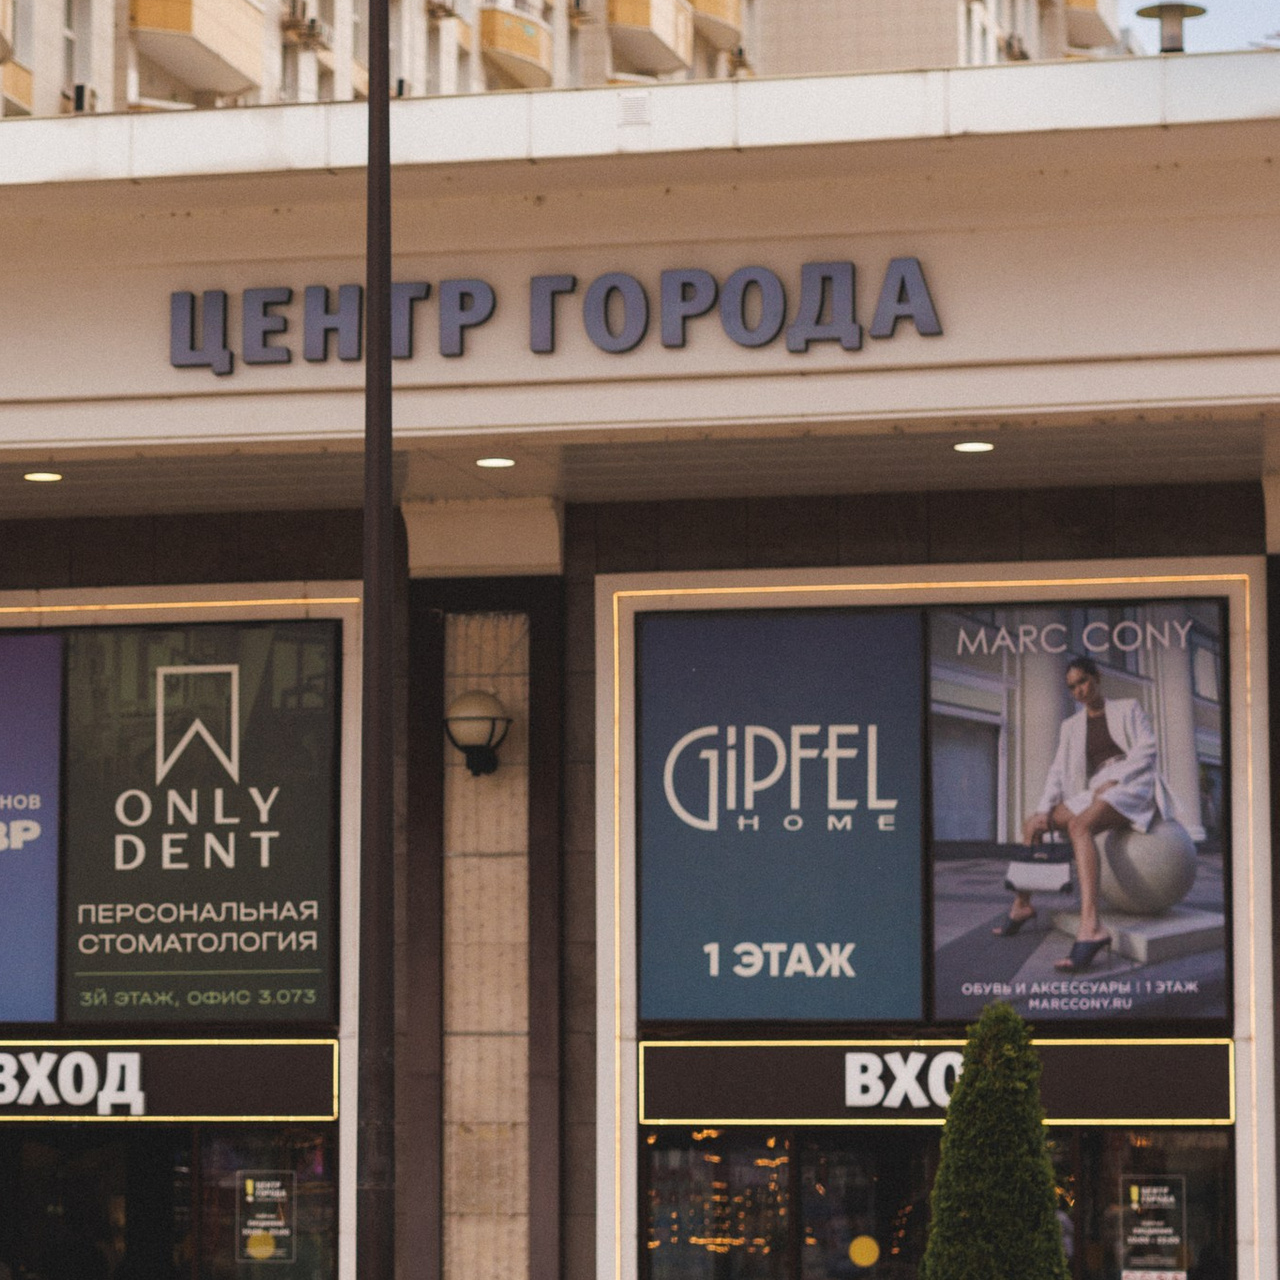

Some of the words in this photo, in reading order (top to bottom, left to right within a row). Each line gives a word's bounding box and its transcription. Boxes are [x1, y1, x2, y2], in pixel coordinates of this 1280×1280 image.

[169, 277, 498, 376] ЦЕНТР
[530, 256, 942, 354] ГОРОДА
[957, 622, 1068, 657] MARC
[1082, 619, 1193, 653] CONY
[114, 786, 280, 827] ONLY
[737, 814, 896, 832] HOME
[114, 831, 280, 871] DENT
[78, 901, 319, 925] ПЕРСОНАЛЬНАЯ
[78, 931, 318, 955] СТОМАТОЛОГИЯ
[703, 942, 720, 977] 1
[732, 941, 856, 978] ЭТАЖ
[187, 988, 252, 1008] ОФИС
[257, 988, 317, 1007] 3.073
[961, 982, 1013, 996] ОБУВЬ
[1015, 982, 1026, 995] И
[1030, 981, 1131, 995] АКСЕССУАРЫ
[1155, 980, 1199, 994] ЭТАЖ
[1028, 997, 1133, 1011] MARCCONY.RU
[844, 1051, 966, 1109] ВХО
